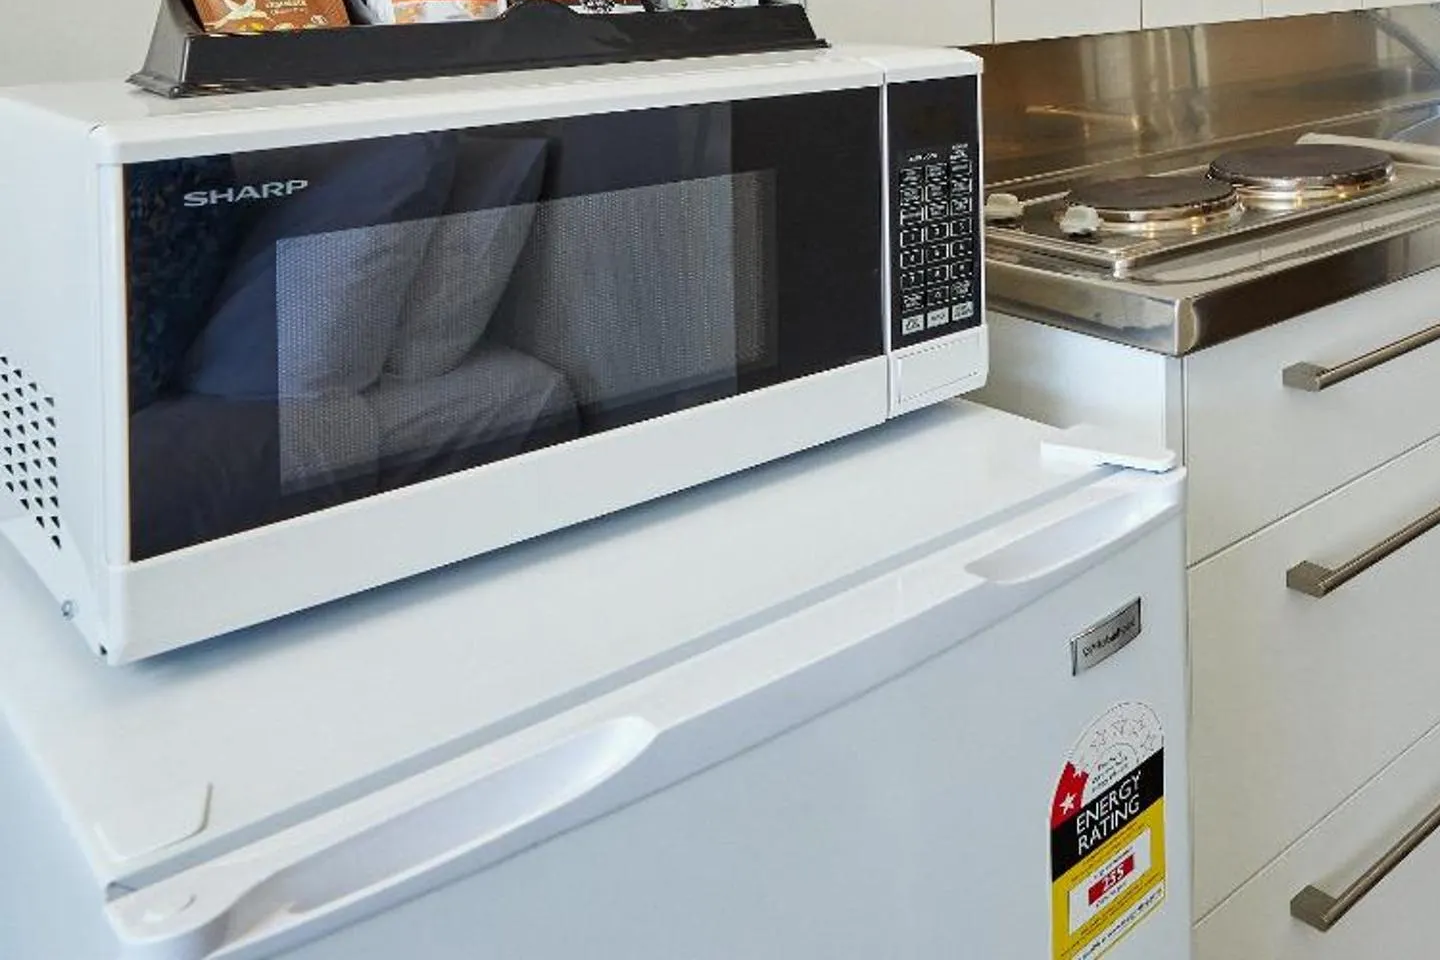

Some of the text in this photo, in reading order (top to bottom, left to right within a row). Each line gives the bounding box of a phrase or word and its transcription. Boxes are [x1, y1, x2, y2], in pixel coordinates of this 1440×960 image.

[183, 179, 309, 208] SHARP
[1077, 770, 1141, 834] ENERGY
[1078, 794, 1140, 855] RATING
